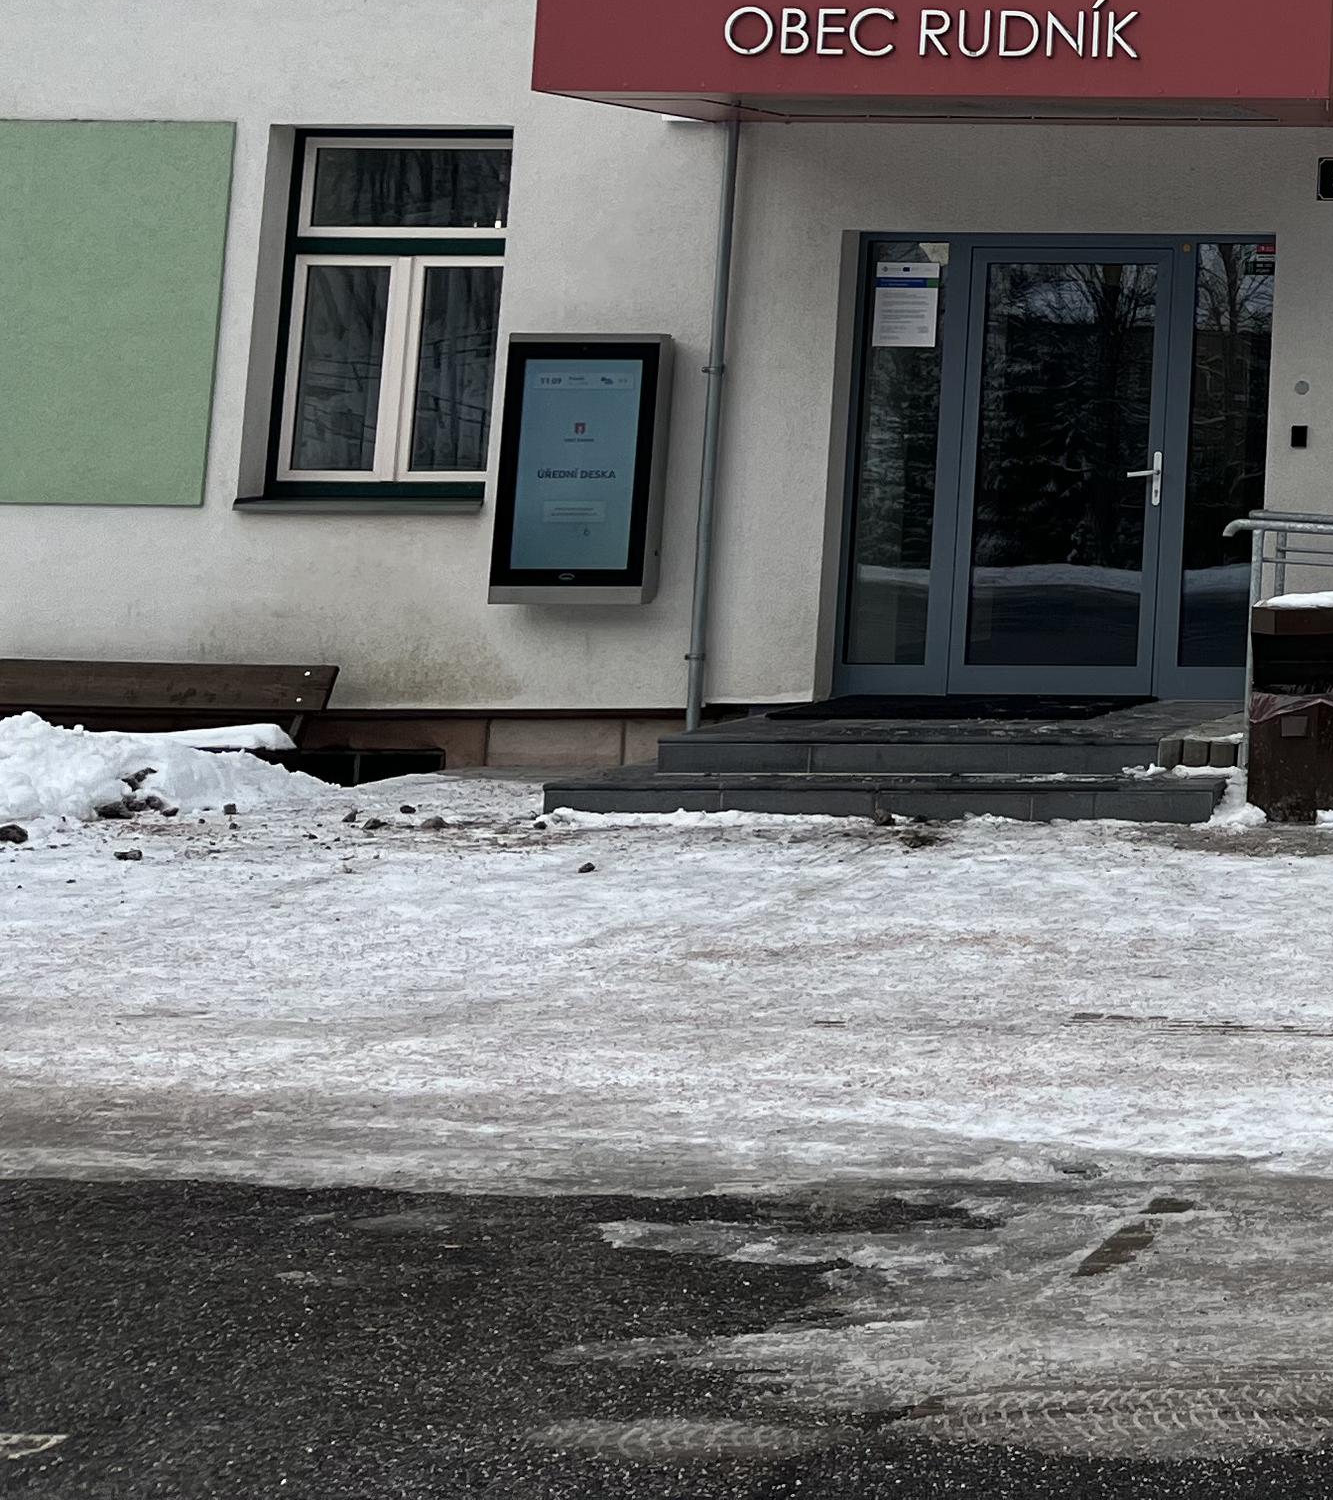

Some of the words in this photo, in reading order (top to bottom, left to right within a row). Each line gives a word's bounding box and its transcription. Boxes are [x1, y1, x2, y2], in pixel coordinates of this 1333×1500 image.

[724, 5, 896, 57] OBEC
[537, 467, 579, 479] ÚŘEDNÍ
[580, 468, 617, 479] DESKA
